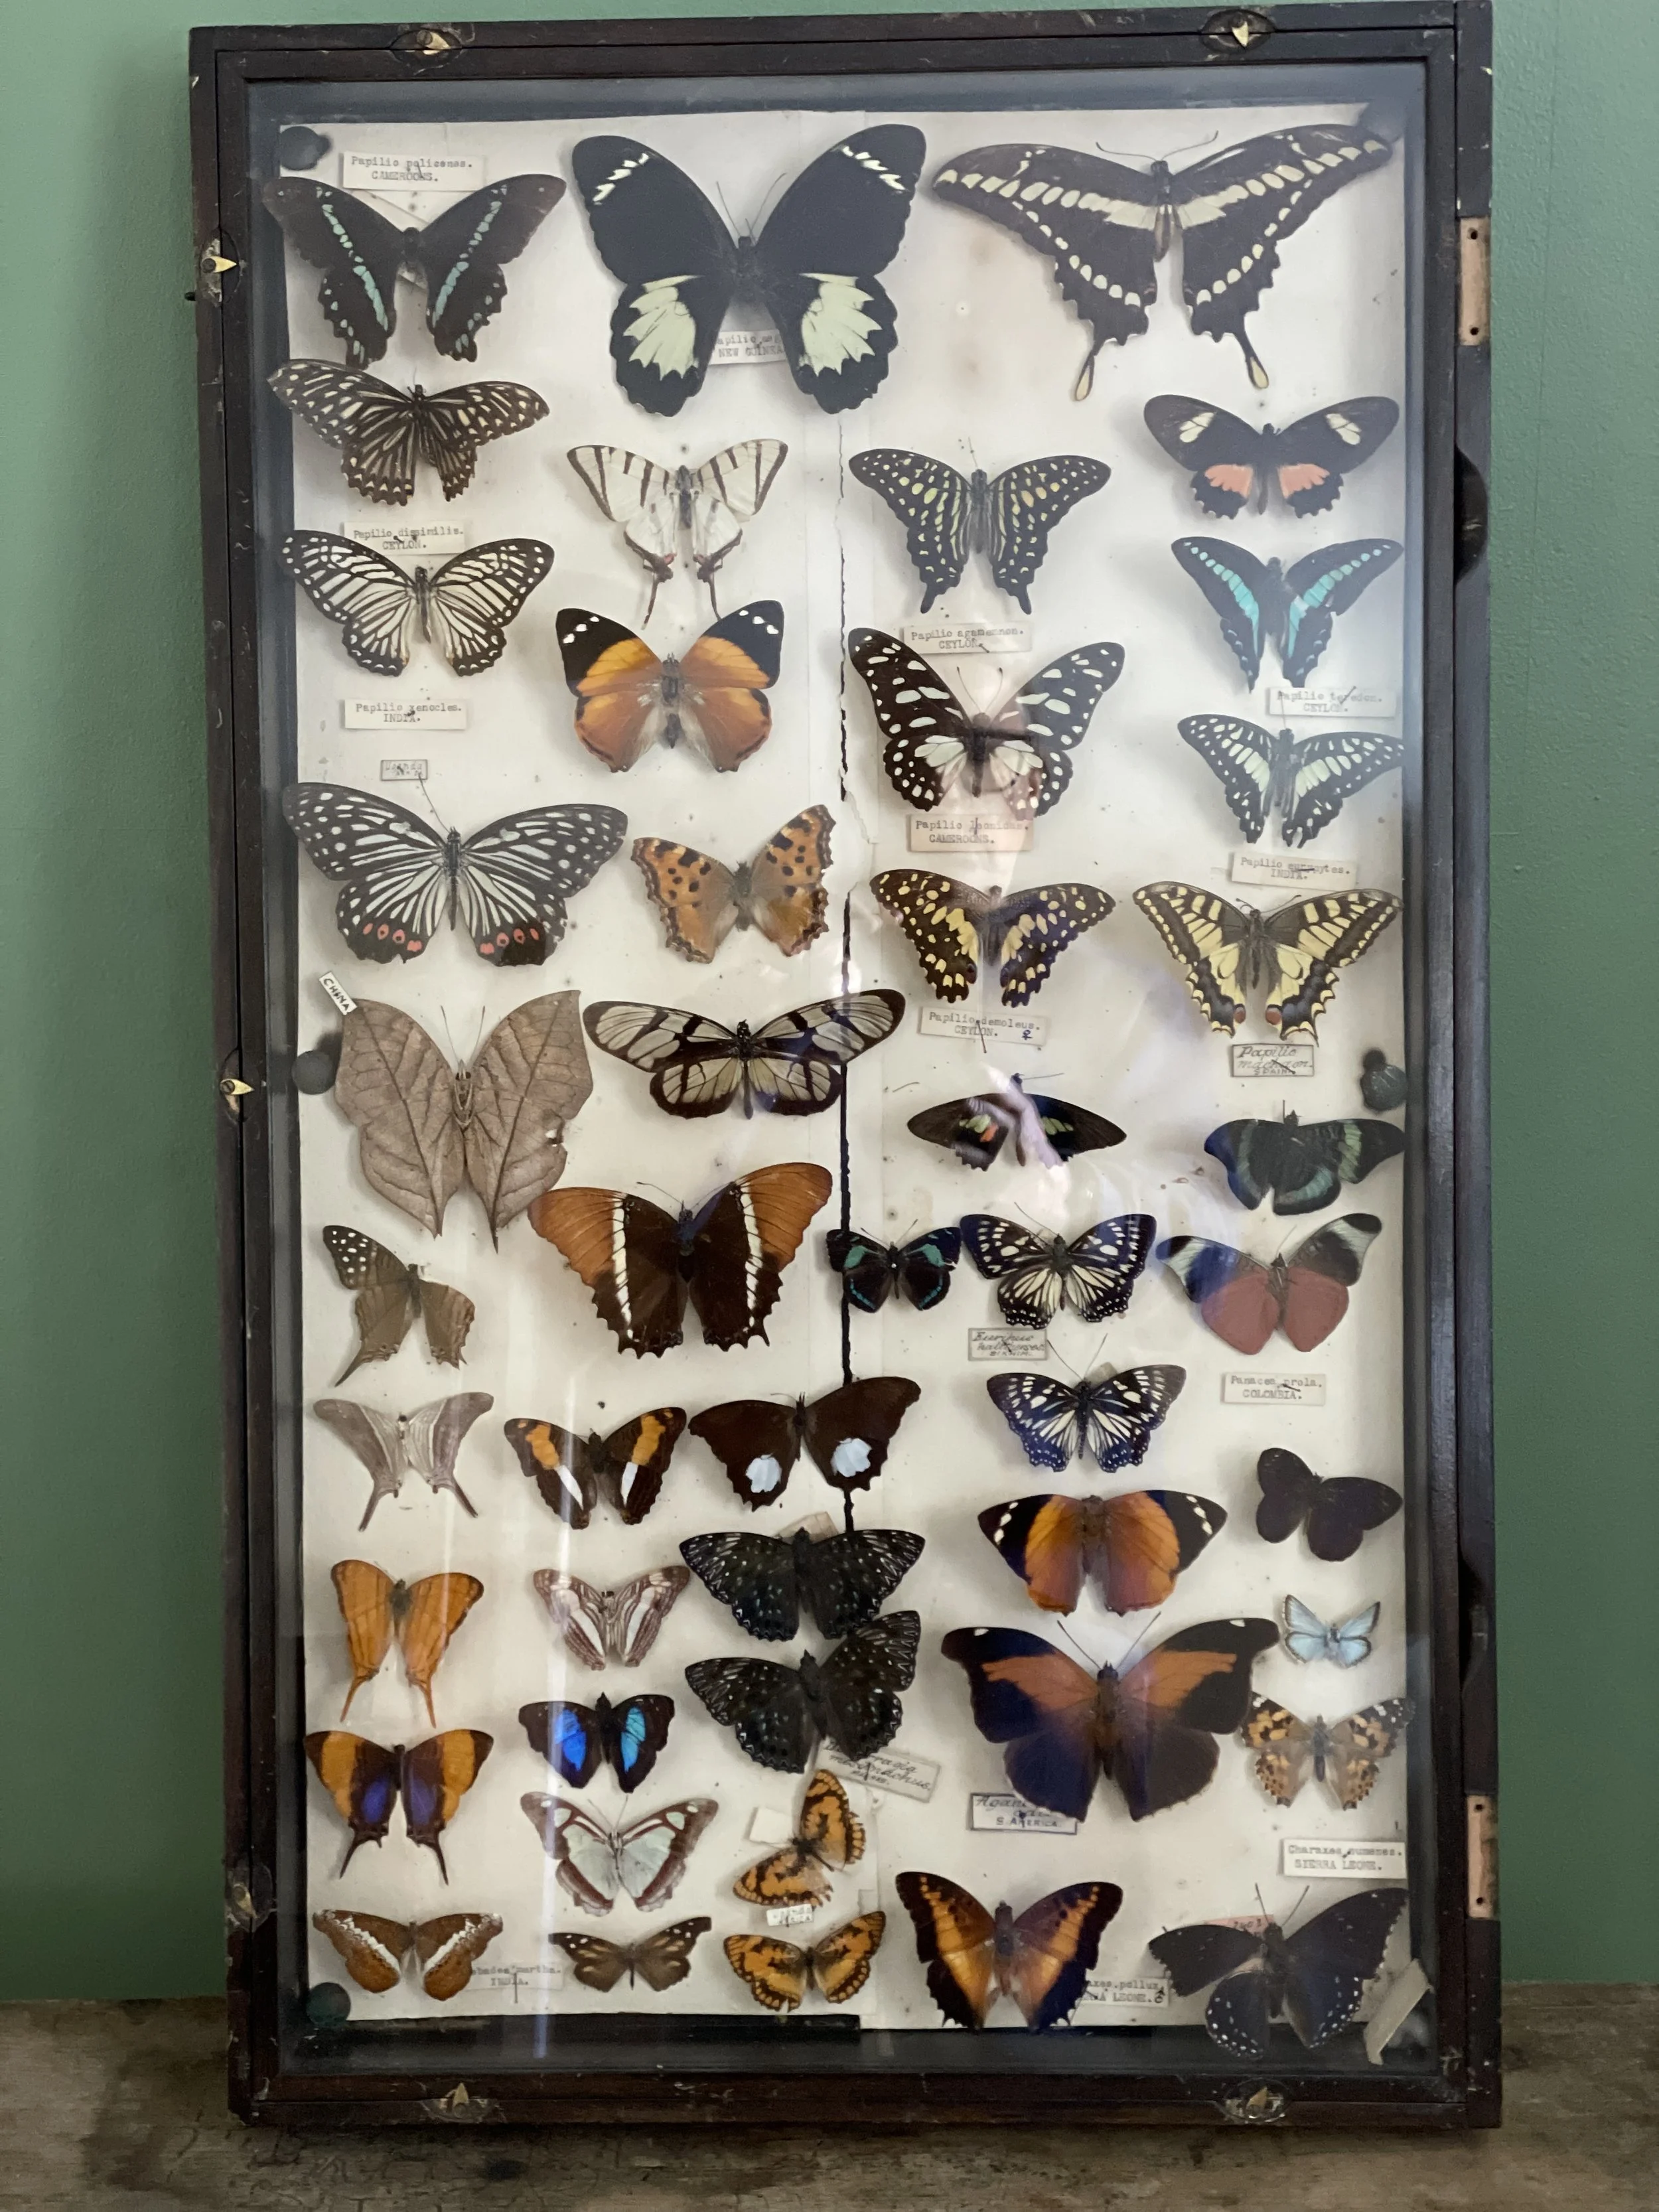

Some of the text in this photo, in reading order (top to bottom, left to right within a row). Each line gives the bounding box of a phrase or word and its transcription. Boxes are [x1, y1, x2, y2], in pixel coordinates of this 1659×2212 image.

[351, 155, 399, 169] Papilio
[716, 334, 756, 346] apilio
[718, 347, 739, 358] NEW
[354, 528, 393, 541] Papilio
[383, 540, 427, 550] CEYLON.
[912, 628, 953, 641] Papilio
[356, 702, 403, 715] Papilio
[384, 713, 421, 723] INDIA.
[916, 820, 962, 832] Papilio
[1240, 857, 1283, 869] Papilio
[323, 978, 350, 1011] CHINA
[929, 1011, 975, 1024] Papilio
[1237, 1045, 1297, 1060] Papilio
